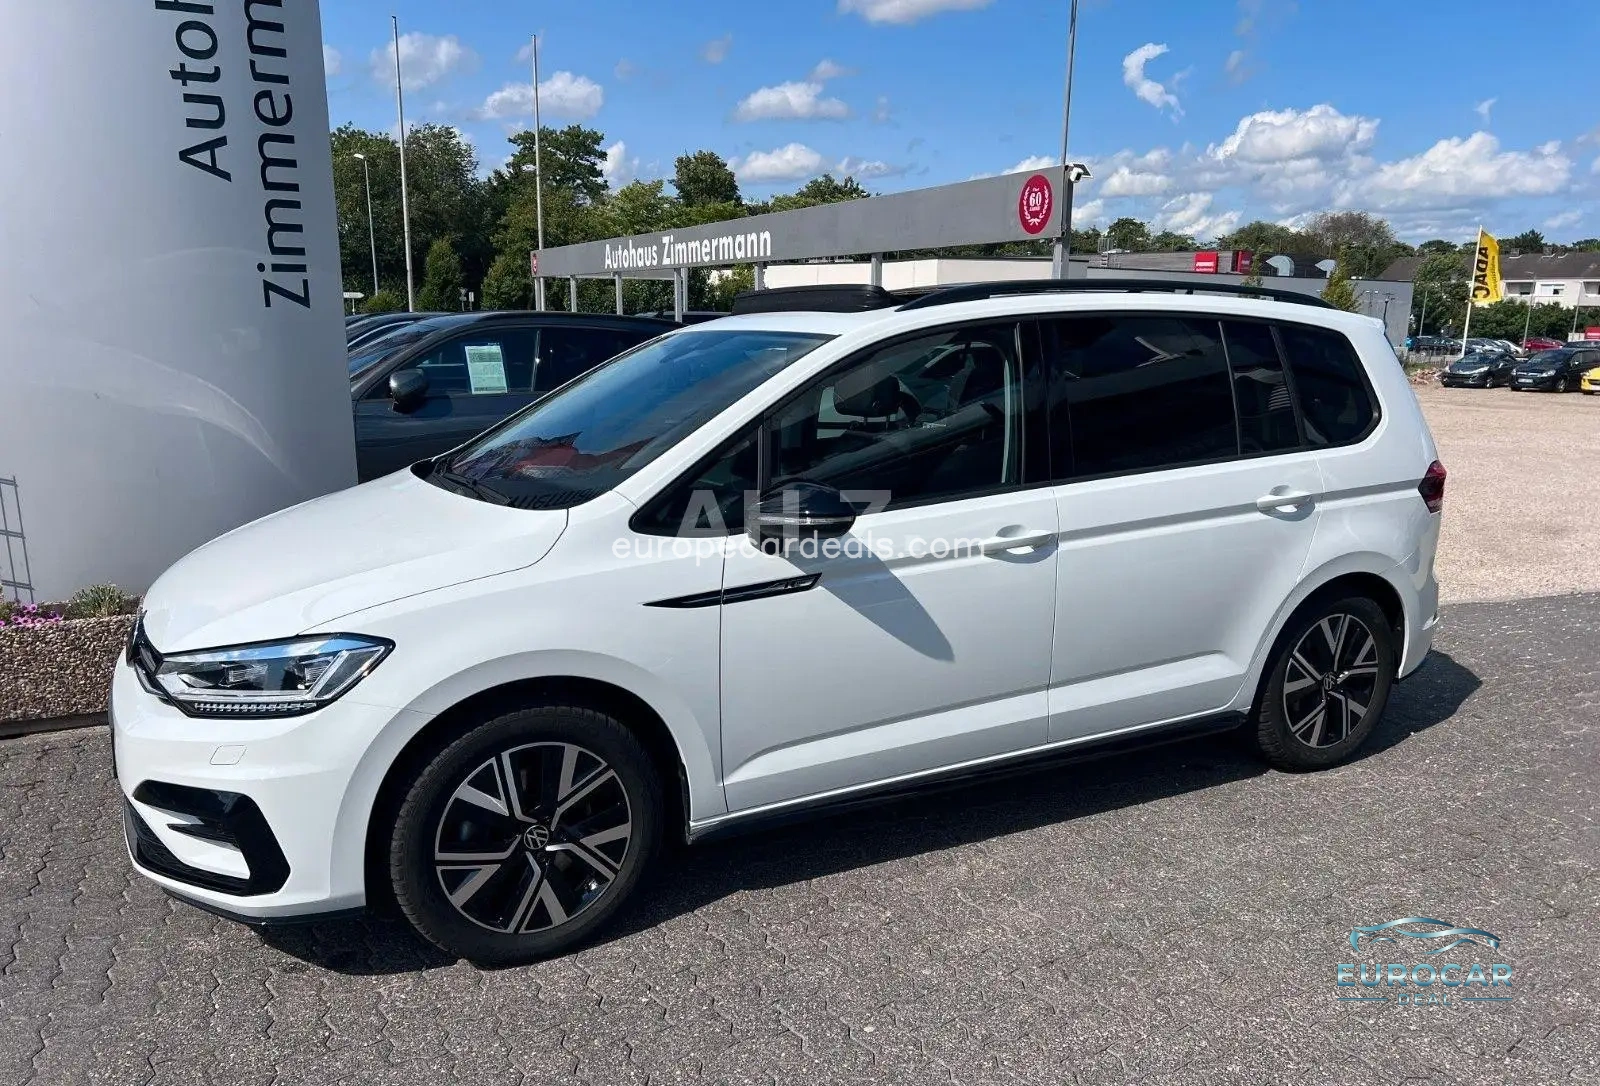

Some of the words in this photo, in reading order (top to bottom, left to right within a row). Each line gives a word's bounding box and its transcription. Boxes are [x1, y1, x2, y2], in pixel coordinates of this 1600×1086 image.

[1029, 192, 1042, 207] 60
[604, 240, 658, 269] Autohaus
[662, 229, 771, 266] Zimmermann
